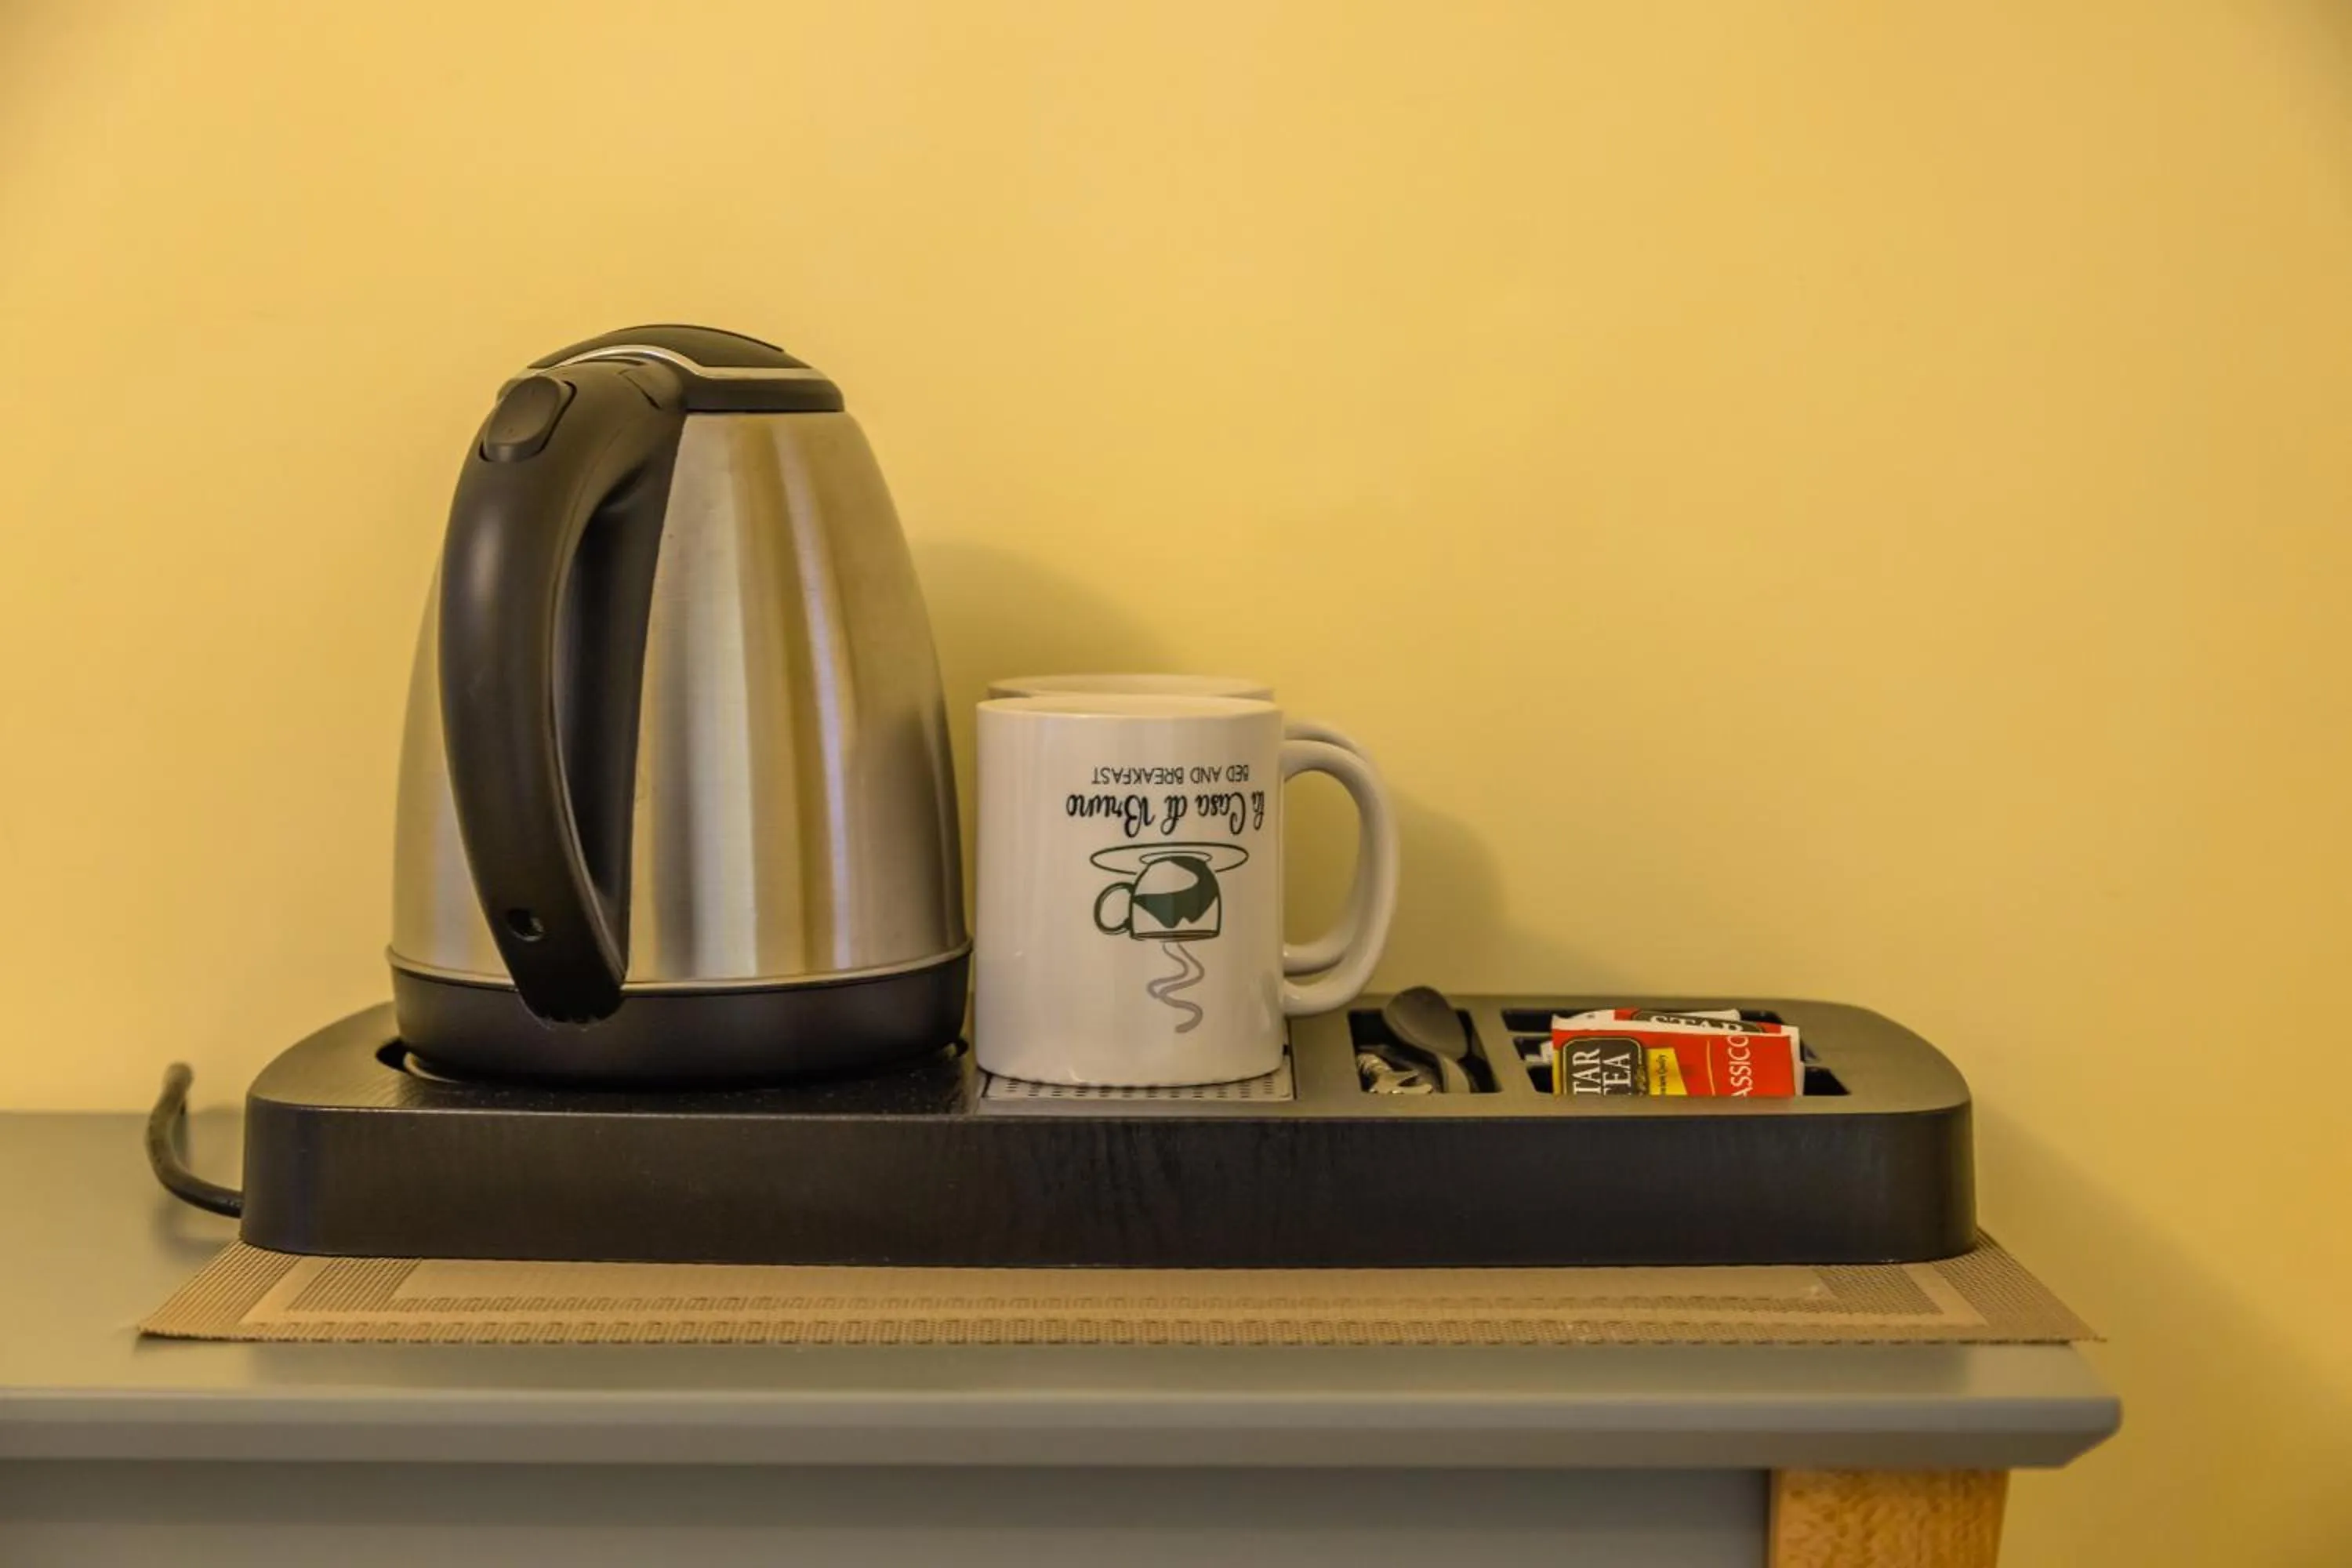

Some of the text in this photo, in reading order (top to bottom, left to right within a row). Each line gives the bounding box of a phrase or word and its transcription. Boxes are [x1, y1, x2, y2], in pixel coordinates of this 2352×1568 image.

[1091, 764, 1249, 784] BED AND BREAKFAST
[1066, 794, 1156, 837] Bruno
[1160, 794, 1188, 836] di
[1194, 791, 1246, 835] Casa
